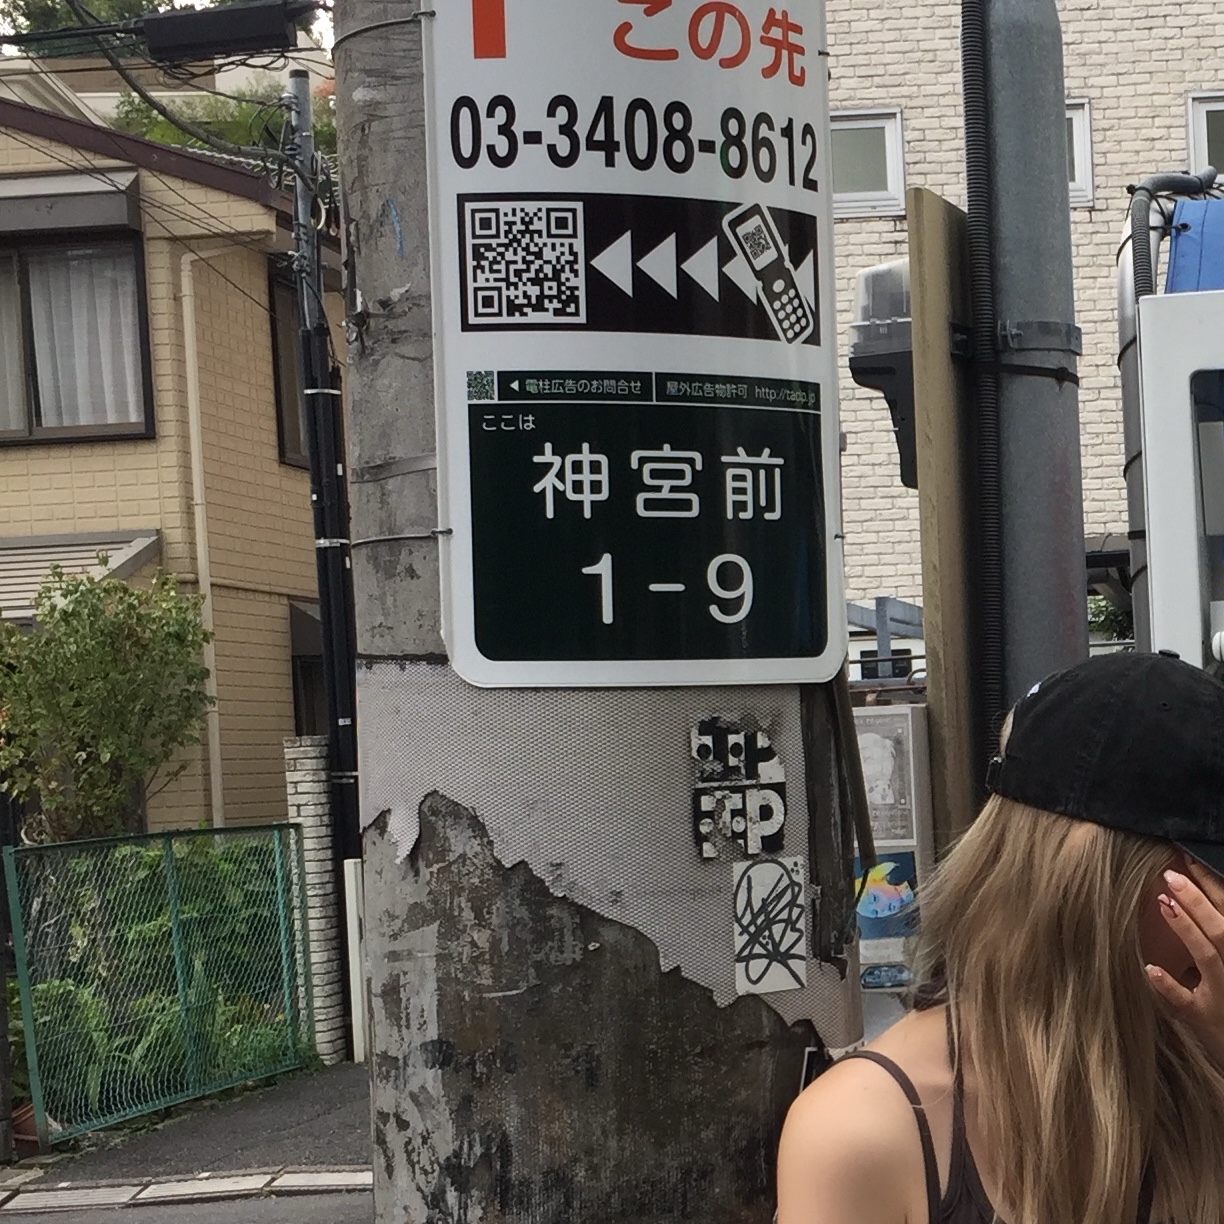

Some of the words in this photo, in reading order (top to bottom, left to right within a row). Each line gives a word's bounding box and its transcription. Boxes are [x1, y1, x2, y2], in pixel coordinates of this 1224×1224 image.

[612, 0, 806, 88] この先
[449, 94, 819, 193] 03-3408-8612
[482, 415, 536, 431] ここは
[524, 378, 642, 395] 電柱広告のお問合せ
[532, 442, 785, 520] 神宮前
[581, 552, 755, 625] 1-9
